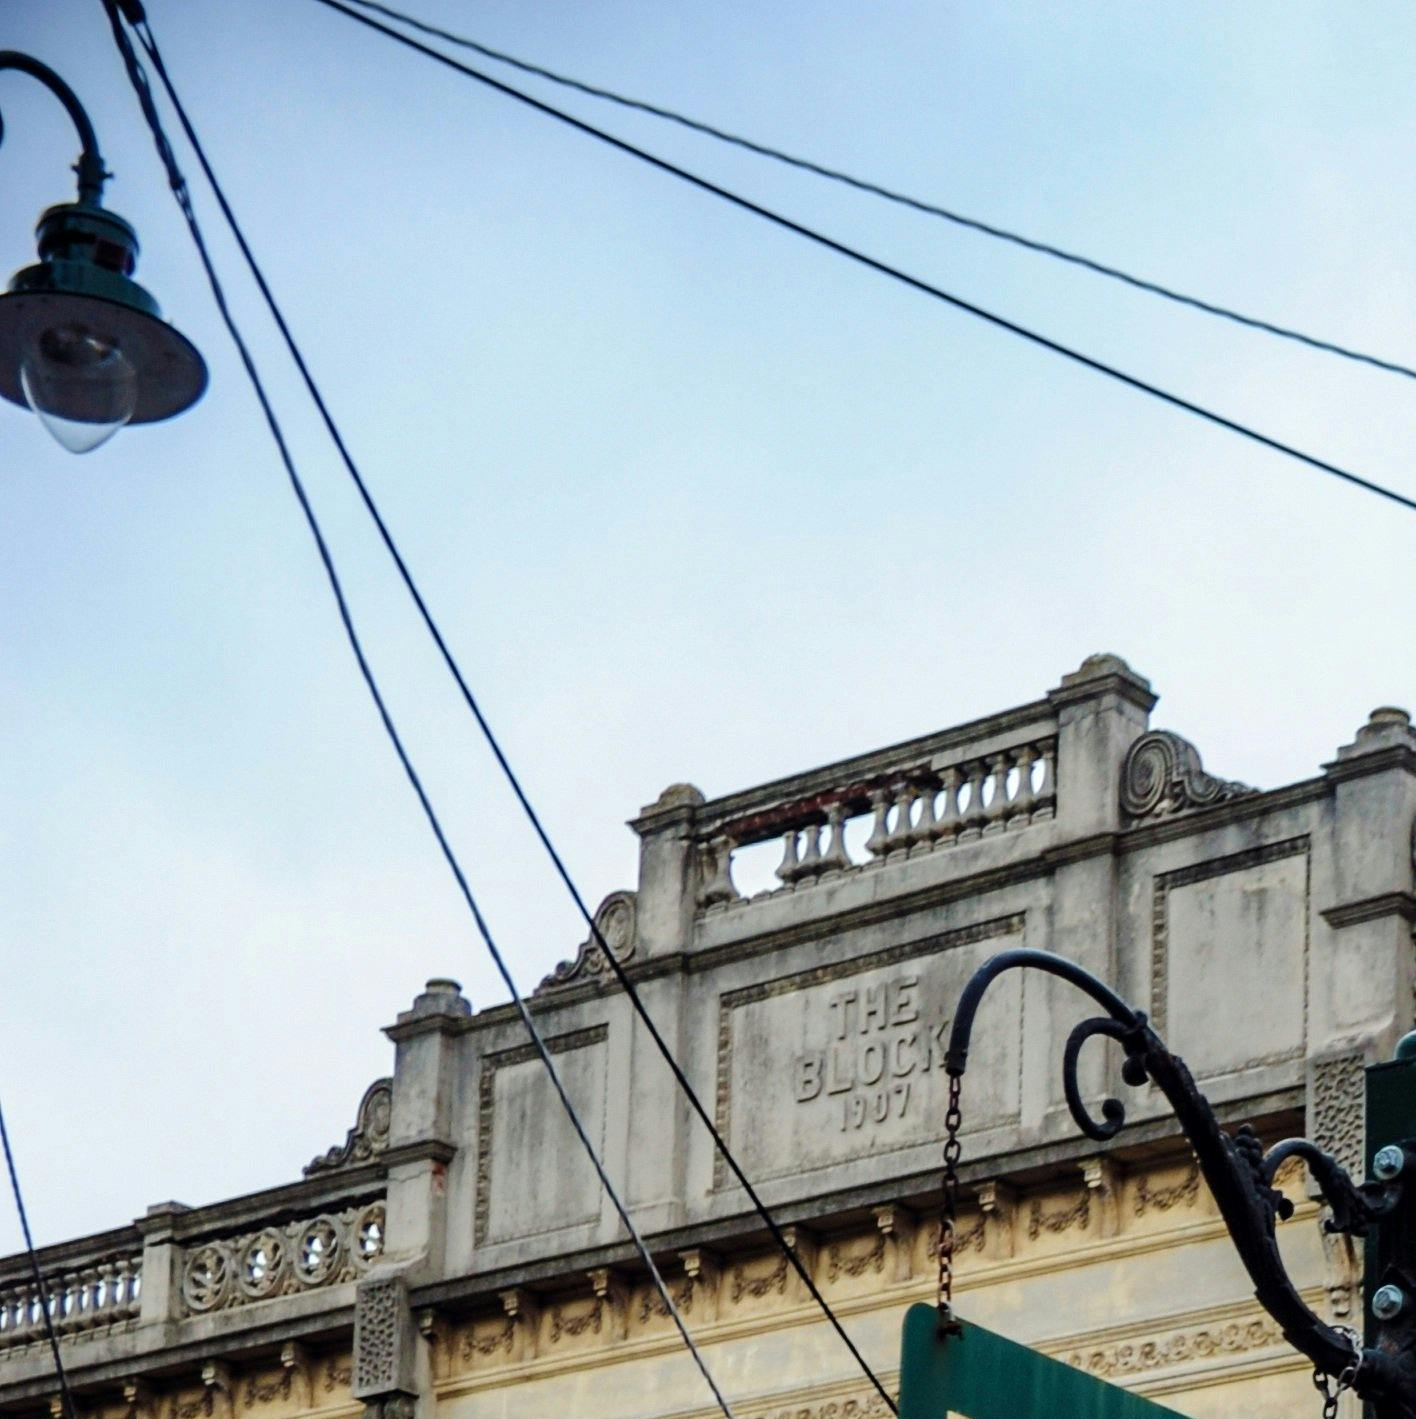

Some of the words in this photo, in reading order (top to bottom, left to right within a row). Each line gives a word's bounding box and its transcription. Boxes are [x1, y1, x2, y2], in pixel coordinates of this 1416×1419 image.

[829, 974, 920, 1040] THE
[795, 1019, 951, 1103] BLOCK
[840, 1082, 912, 1132] 1907
